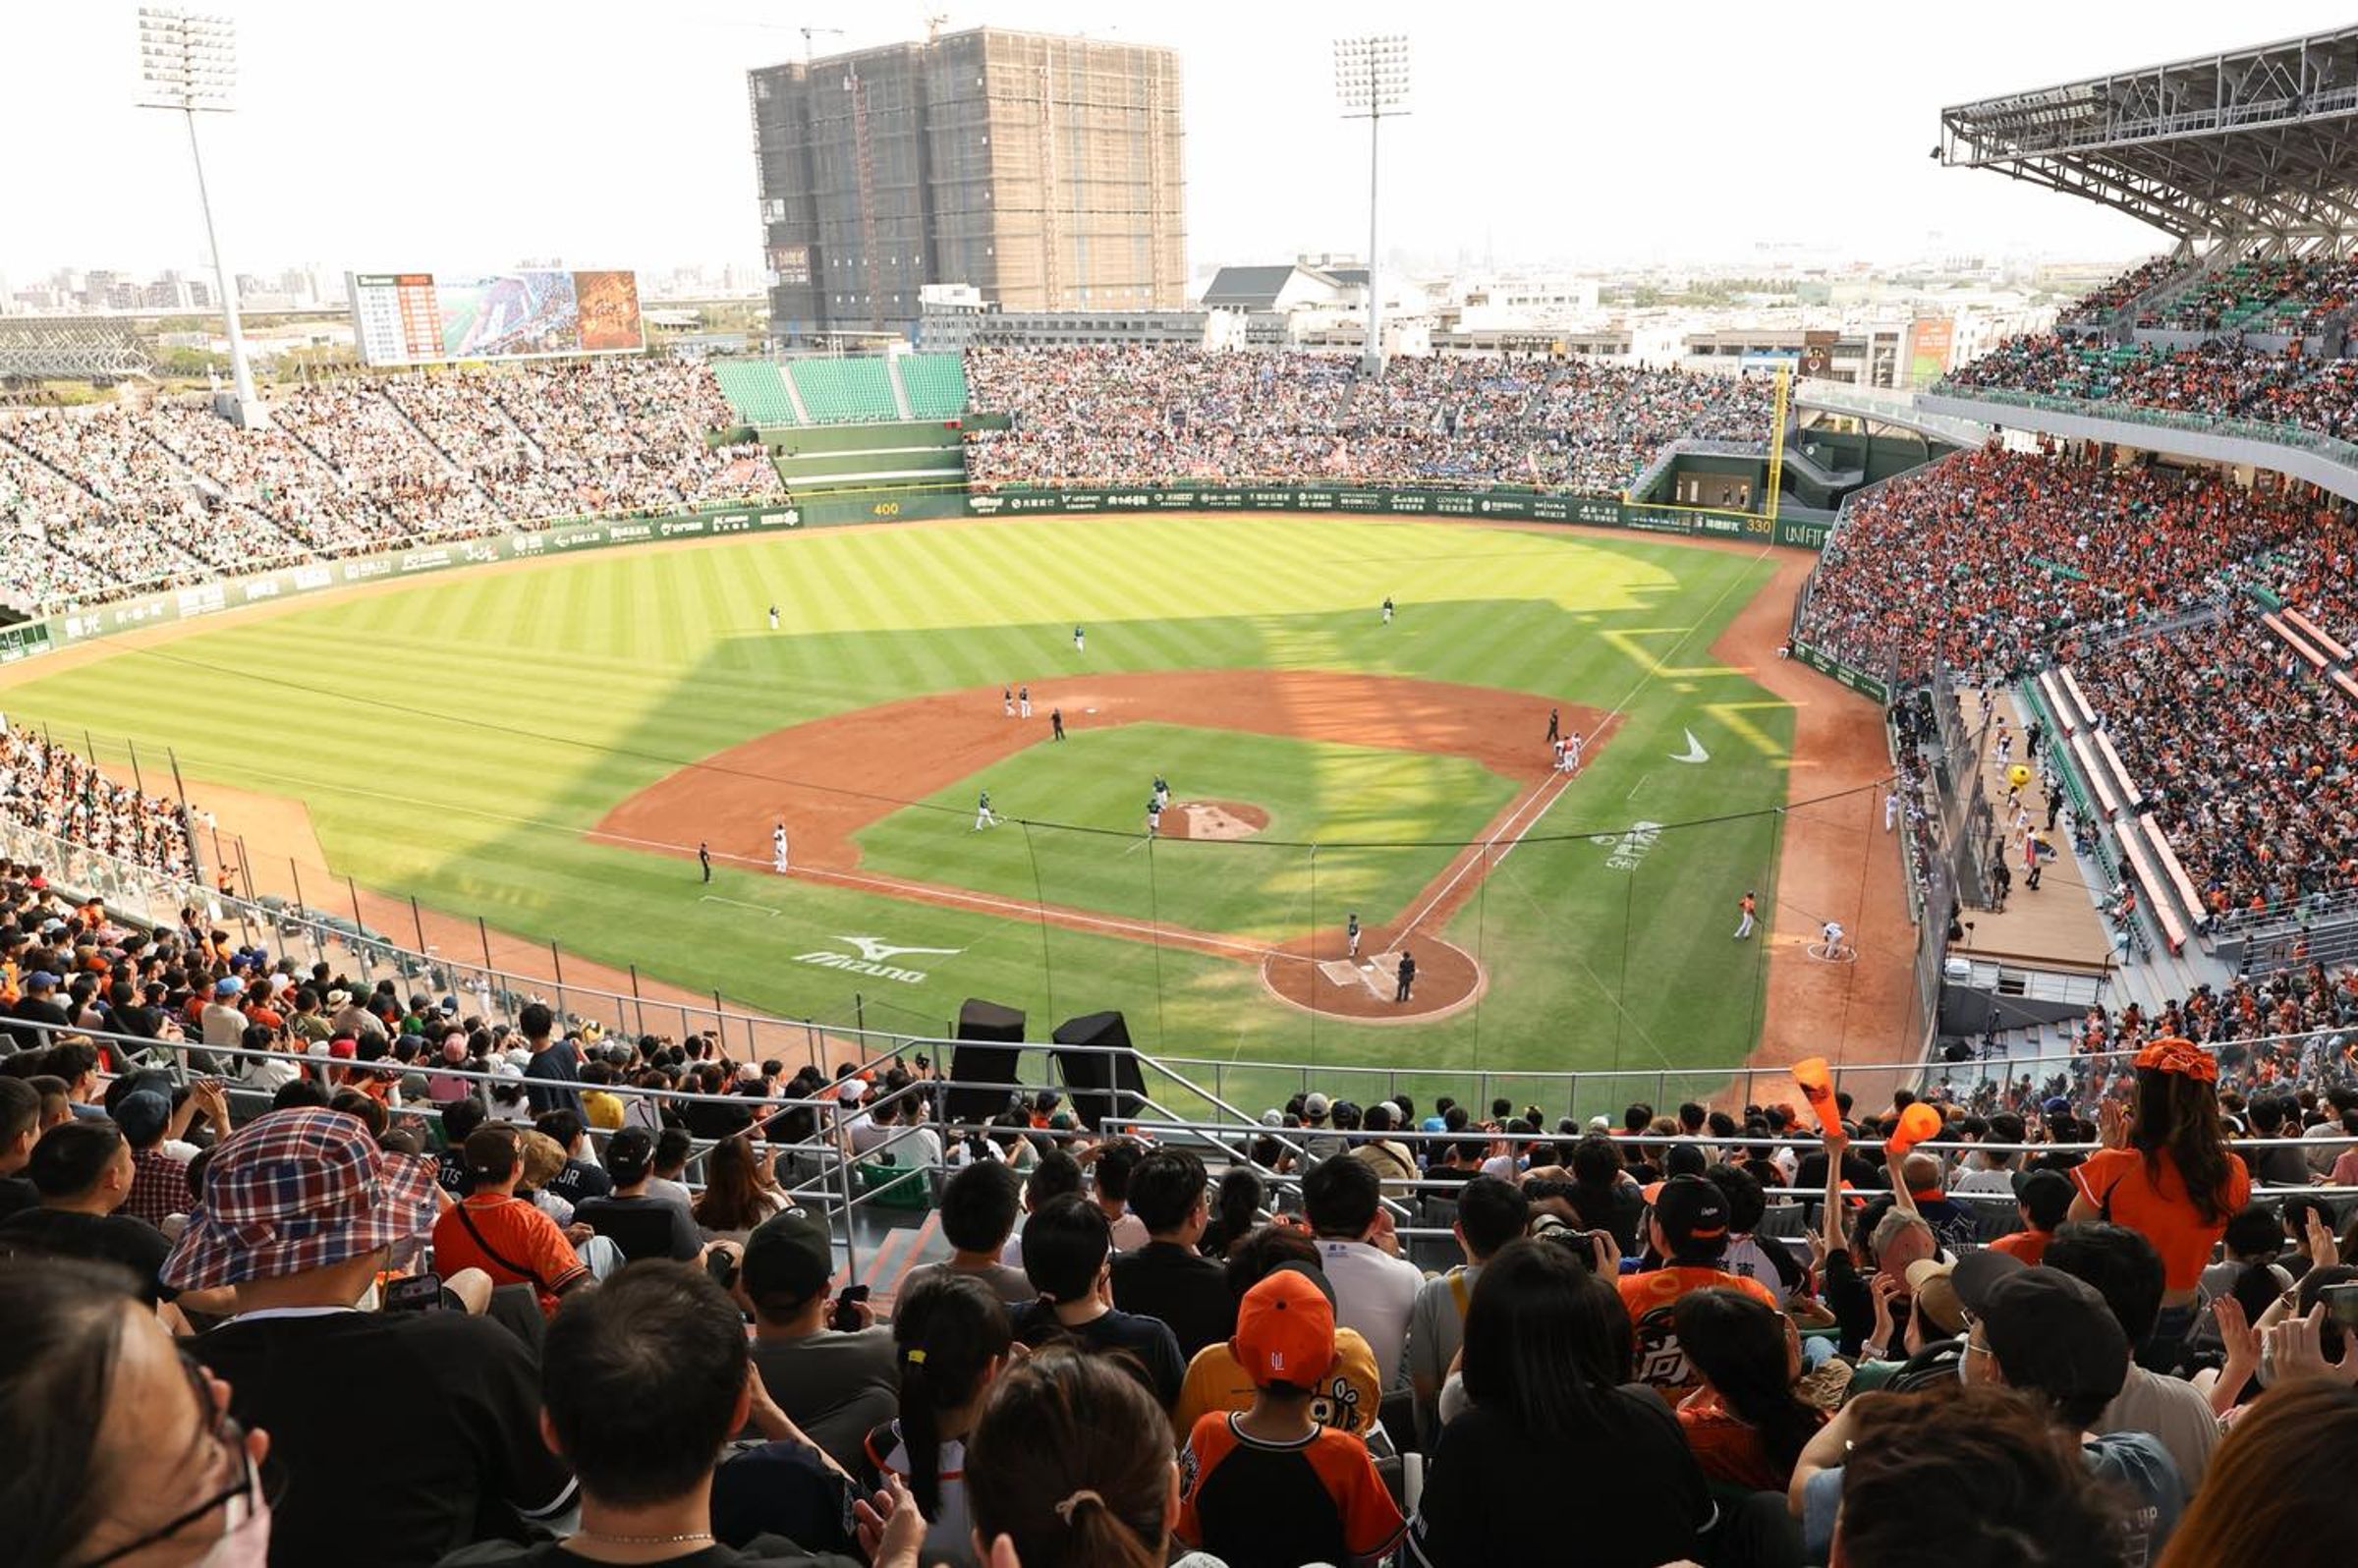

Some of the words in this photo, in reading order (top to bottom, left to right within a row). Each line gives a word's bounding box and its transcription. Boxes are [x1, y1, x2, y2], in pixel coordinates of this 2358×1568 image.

[874, 502, 898, 516] 400
[1747, 519, 1771, 534] 330
[791, 951, 927, 983] MIZUNO
